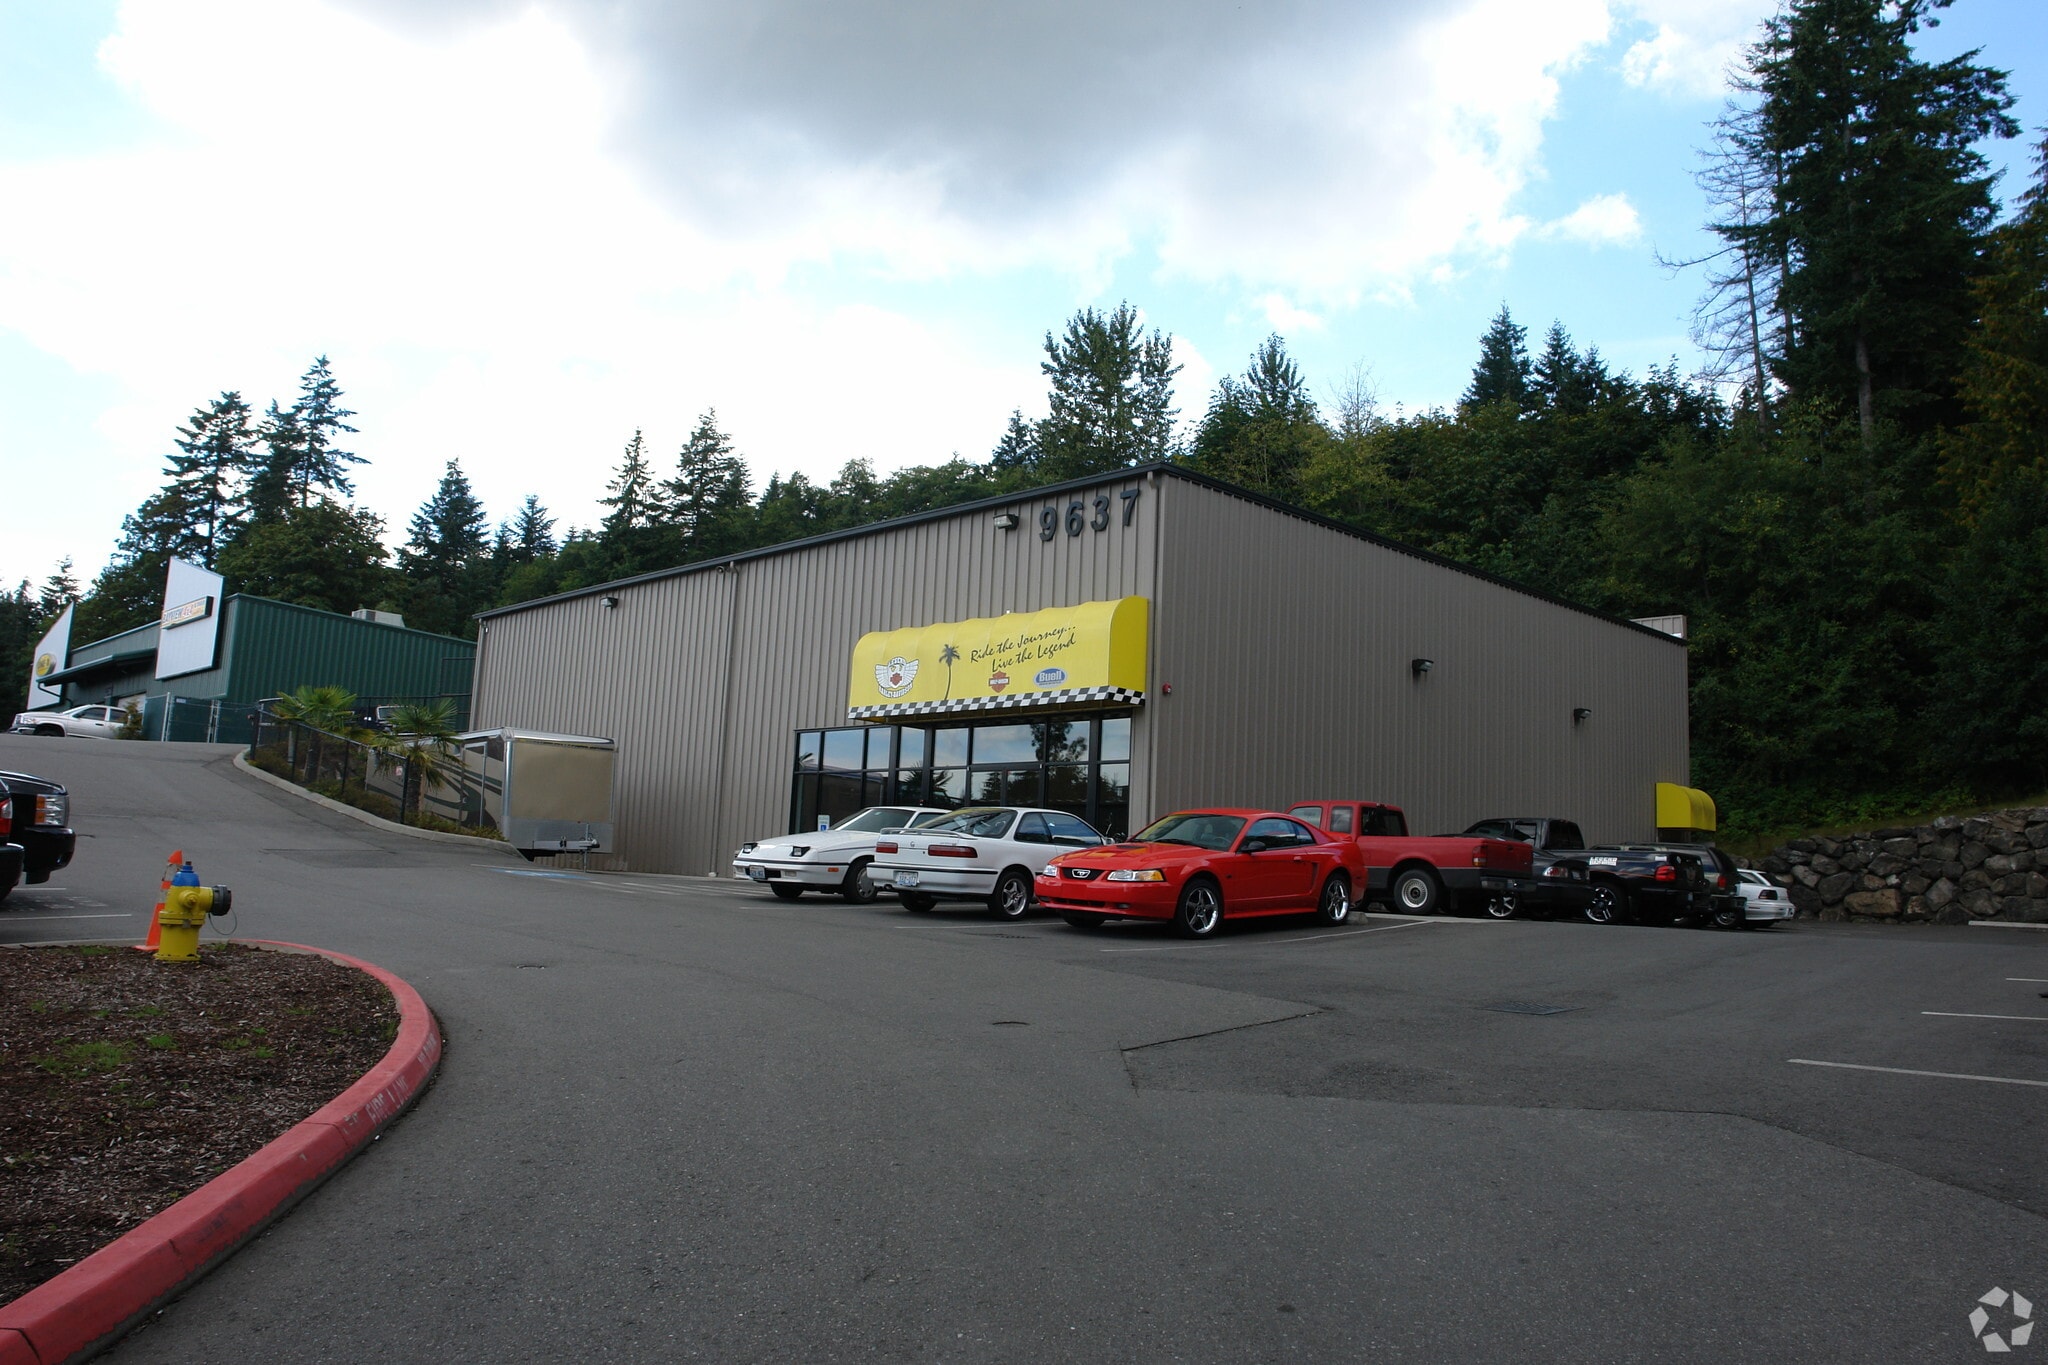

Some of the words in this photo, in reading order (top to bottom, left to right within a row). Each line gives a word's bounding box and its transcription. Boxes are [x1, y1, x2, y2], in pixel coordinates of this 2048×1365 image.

[1039, 488, 1140, 541] 9637
[970, 643, 995, 663] Ride
[996, 638, 1014, 654] the
[1017, 625, 1076, 648] Journey...
[992, 657, 1014, 673] Live
[1016, 648, 1033, 664] the
[1037, 632, 1077, 659] Legend
[1039, 670, 1062, 682] Buell
